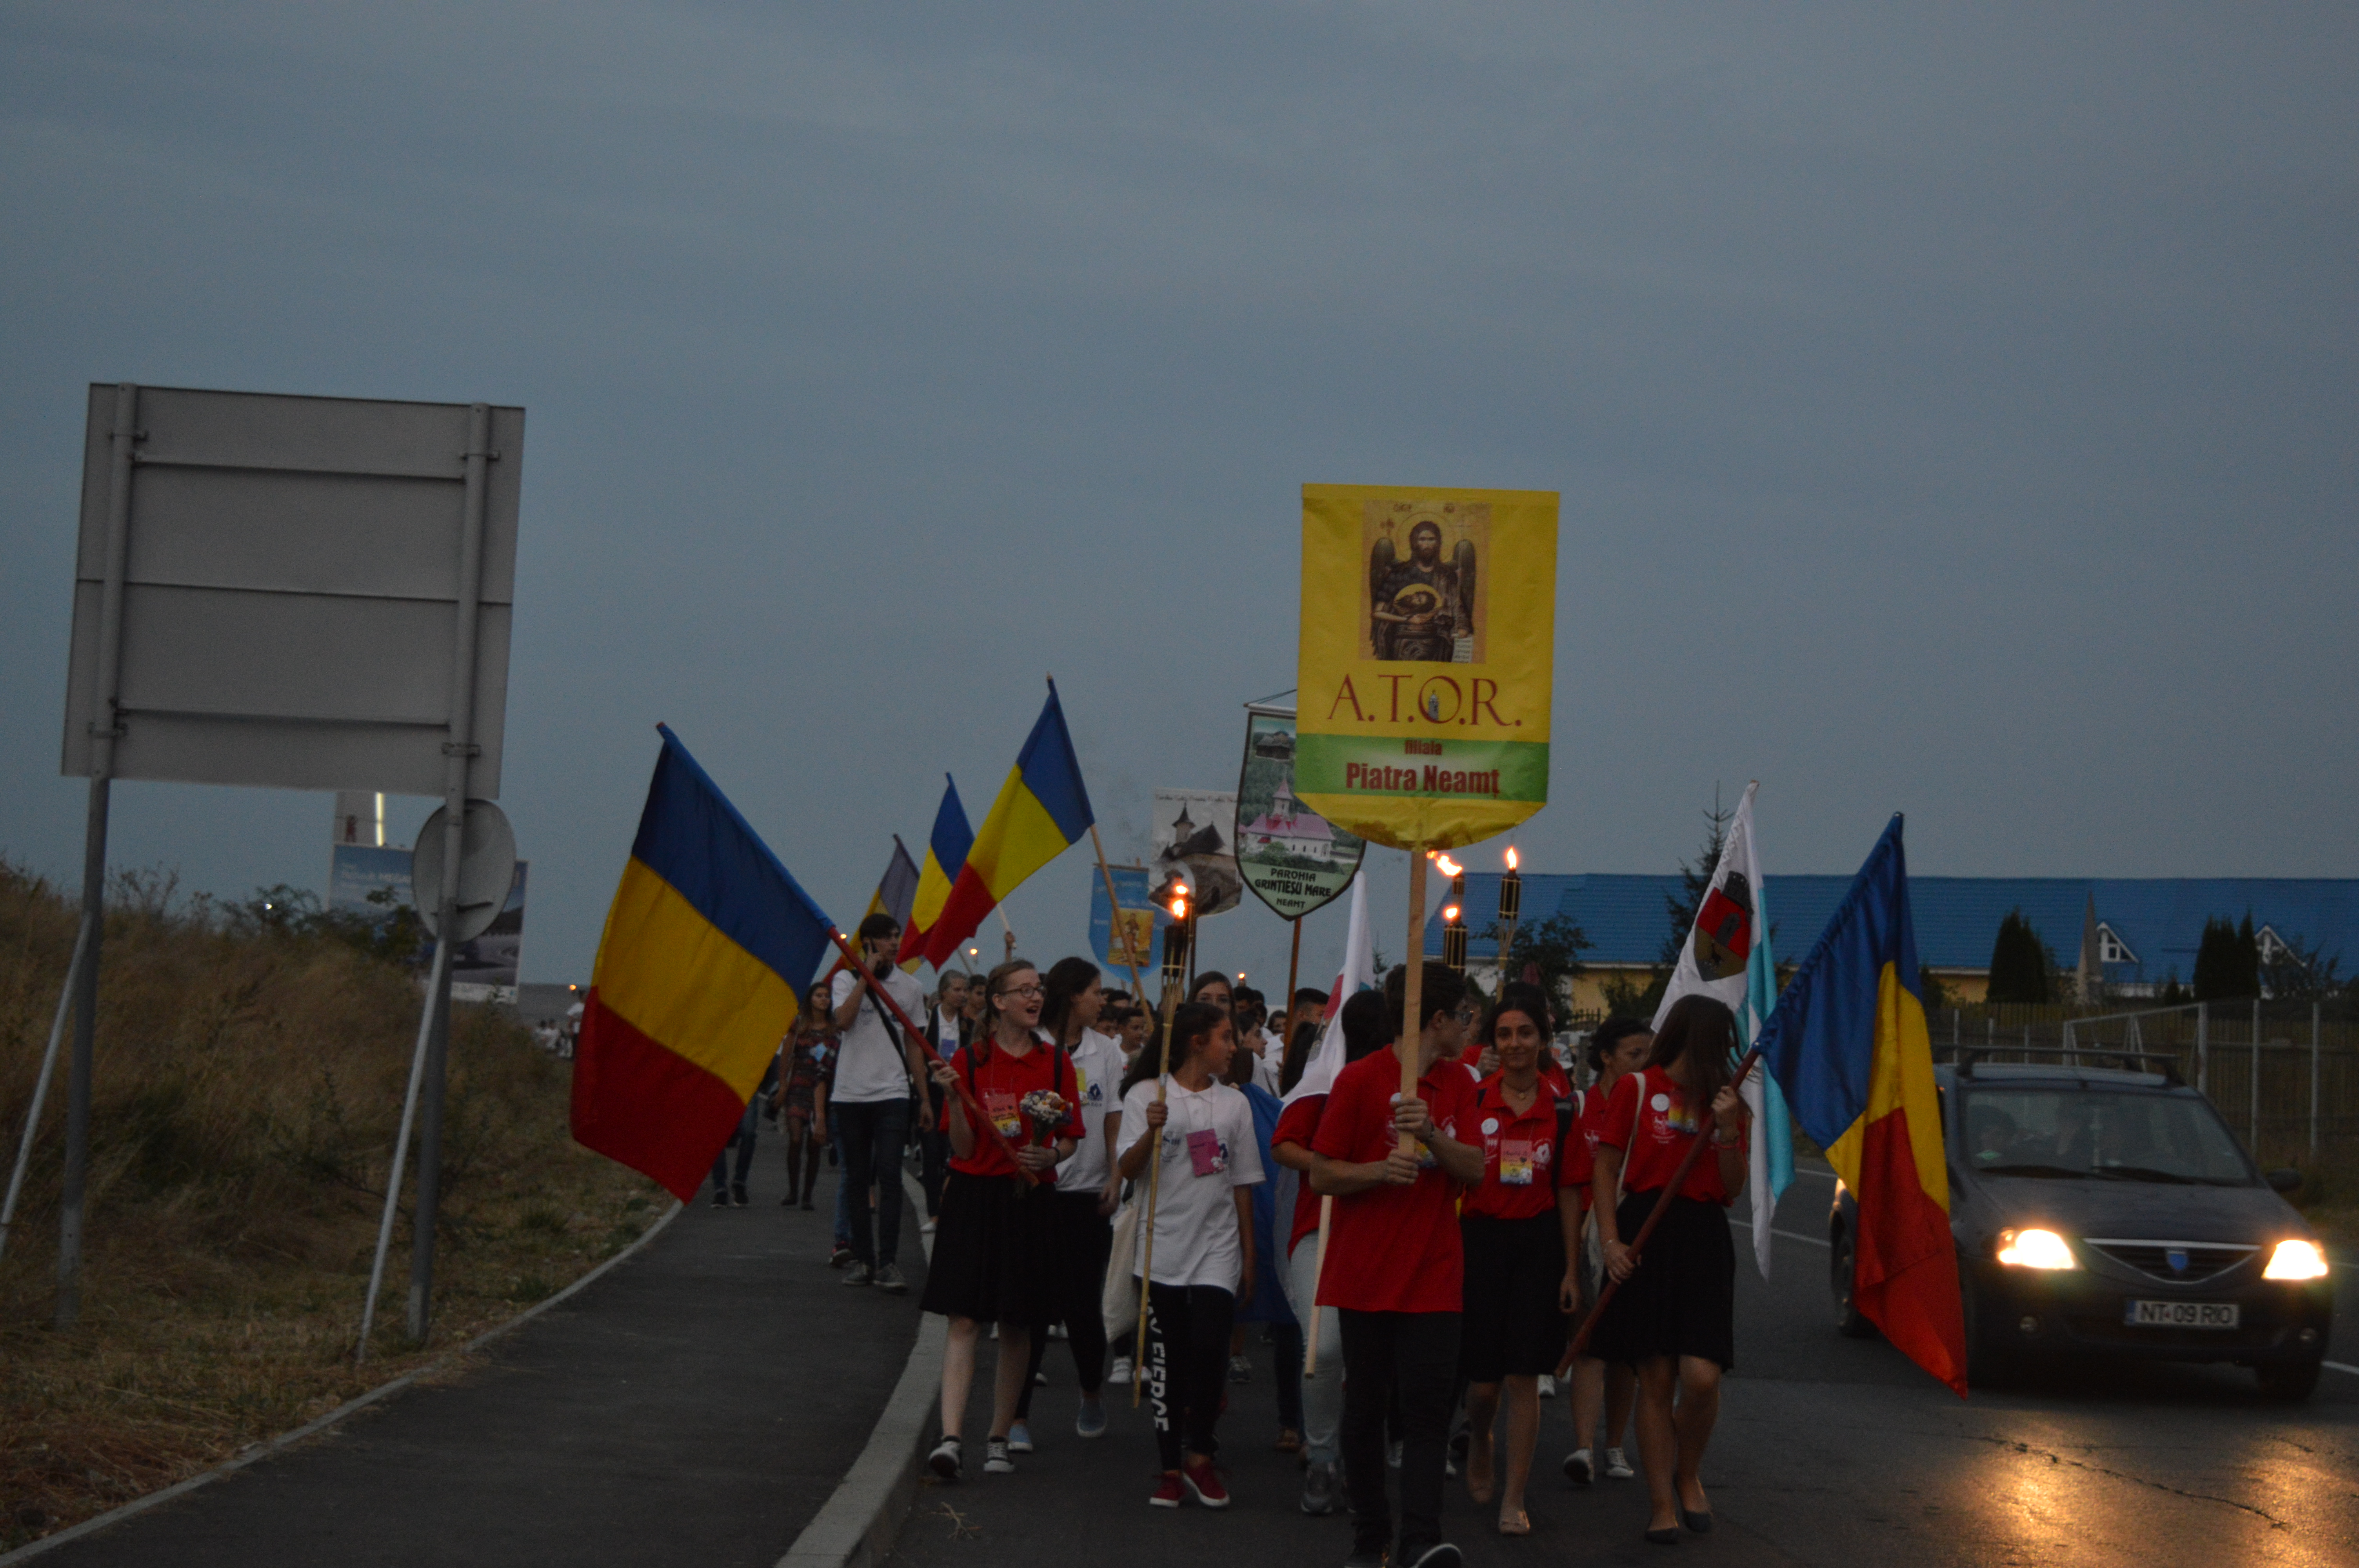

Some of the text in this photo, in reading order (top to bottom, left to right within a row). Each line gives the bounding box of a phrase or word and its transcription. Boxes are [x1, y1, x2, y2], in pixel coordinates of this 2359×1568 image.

[1327, 674, 1522, 726] A.T.O.R.
[1405, 739, 1442, 755] filiala
[1346, 762, 1417, 791] Piatra
[1271, 868, 1316, 882] PAROHIA
[1305, 884, 1331, 897] MARE
[2141, 1303, 2166, 1321] NT
[2175, 1305, 2196, 1323] 09
